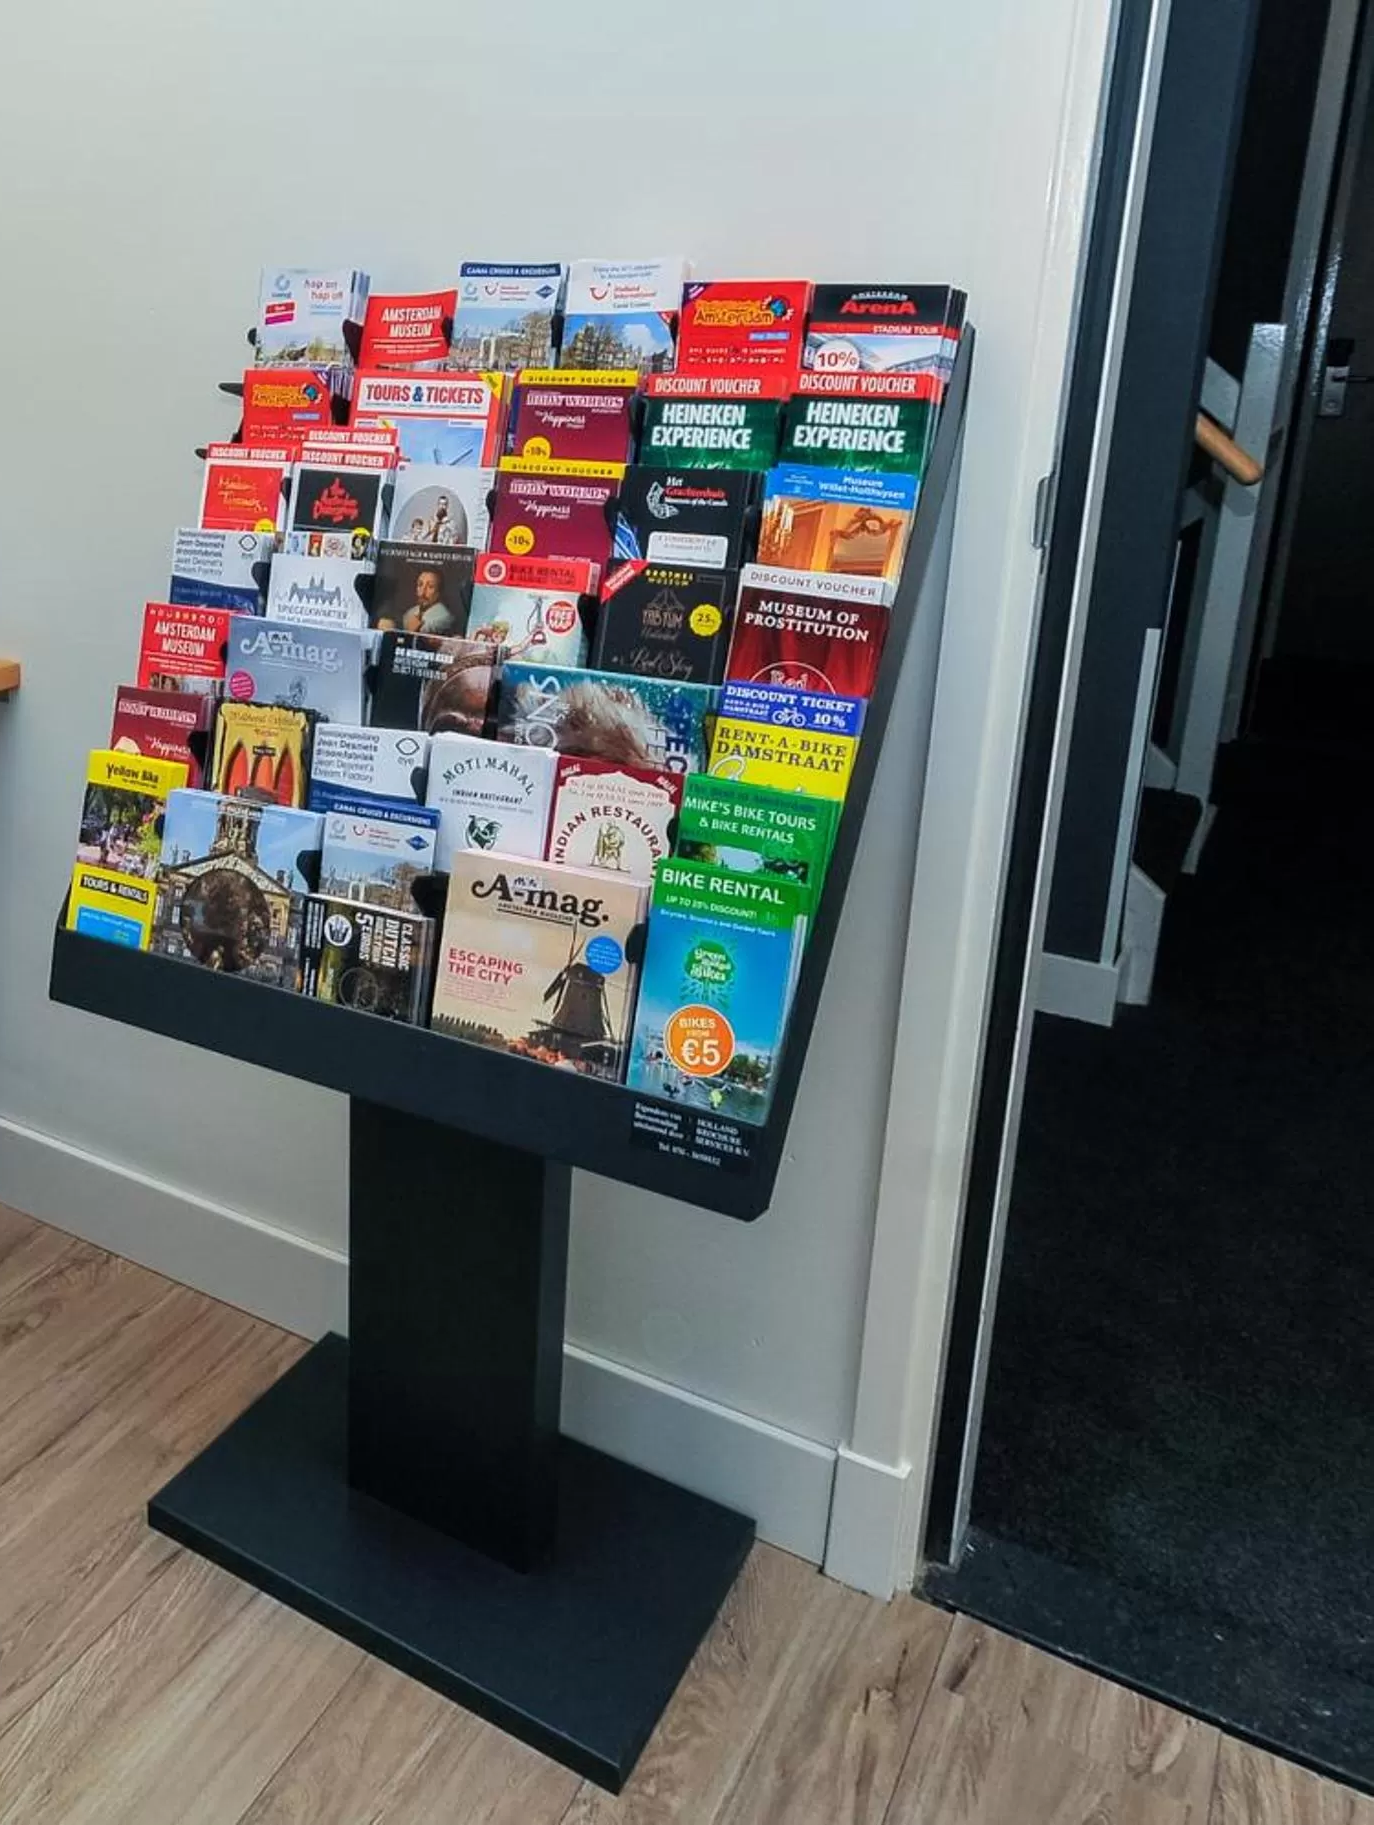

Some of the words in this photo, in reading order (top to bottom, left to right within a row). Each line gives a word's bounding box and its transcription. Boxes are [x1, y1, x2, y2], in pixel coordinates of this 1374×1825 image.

[381, 305, 442, 322] AMSTERDAM
[840, 301, 917, 315] ArenA
[389, 323, 433, 337] MUSEUM
[873, 325, 911, 333] STADIUM
[913, 326, 938, 334] TOUR
[818, 350, 857, 367] 10%
[655, 375, 708, 393] DISCOUNT
[711, 376, 761, 395] VOUCHER
[799, 373, 859, 392] DISCOUNT
[862, 375, 916, 394] VOUCHER
[366, 384, 411, 401] TOURS
[413, 386, 424, 402] &
[426, 387, 484, 404] TICKETS
[662, 403, 746, 425] HEINEKEN
[806, 402, 900, 427] HEINEKEN
[309, 430, 350, 442] DISCOUNT
[353, 431, 391, 444] VOUCHER
[651, 426, 751, 450] EXPERIENCE
[794, 428, 905, 453] EXPERIENCE
[210, 446, 248, 458] DISCOUNT
[250, 448, 287, 460] VOUCHER
[302, 450, 343, 463] DISCOUNT
[345, 453, 384, 466] VOUCHER
[512, 463, 561, 471] DISCOUNT
[842, 476, 884, 488] Museum
[750, 571, 811, 588] DISCOUNT
[816, 580, 877, 597] VOUCHER
[758, 600, 833, 622] MUSEUM
[837, 610, 860, 625] OF
[154, 620, 217, 642] AMSTERDAM
[744, 613, 870, 643] PROSTITUTION
[161, 637, 205, 657] MUSEUM
[770, 669, 808, 689] Red
[726, 685, 798, 704] DISCOUNT
[801, 695, 856, 713] TICKET
[813, 713, 846, 728] 10%
[717, 740, 844, 773] DAMSTRAAT
[106, 763, 139, 779] Yellow
[141, 769, 159, 783] Bike
[442, 757, 481, 785] MOTI
[484, 757, 534, 796] MAHAL
[333, 803, 356, 813] CANAL
[684, 797, 731, 816] MIKE'S
[734, 805, 765, 822] BIKE
[768, 811, 817, 831] TOURS
[555, 811, 587, 864] INDIAN
[699, 818, 708, 828] &
[711, 819, 738, 833] BIKE
[741, 825, 795, 844] RENTALS
[83, 875, 109, 891] TOURS
[662, 868, 705, 890] BIKE
[709, 877, 785, 905] RENTAL
[471, 874, 609, 928] A-mag.
[666, 895, 678, 903] UP
[679, 896, 691, 906] TO
[355, 912, 374, 926] 5
[381, 919, 400, 969] DUTCH
[448, 948, 523, 976] ESCAPING
[448, 962, 474, 979] THE
[478, 968, 513, 986] CITY
[678, 1017, 716, 1029] BIKES
[681, 1038, 721, 1066] €5
[697, 1118, 739, 1136] HOLLAND
